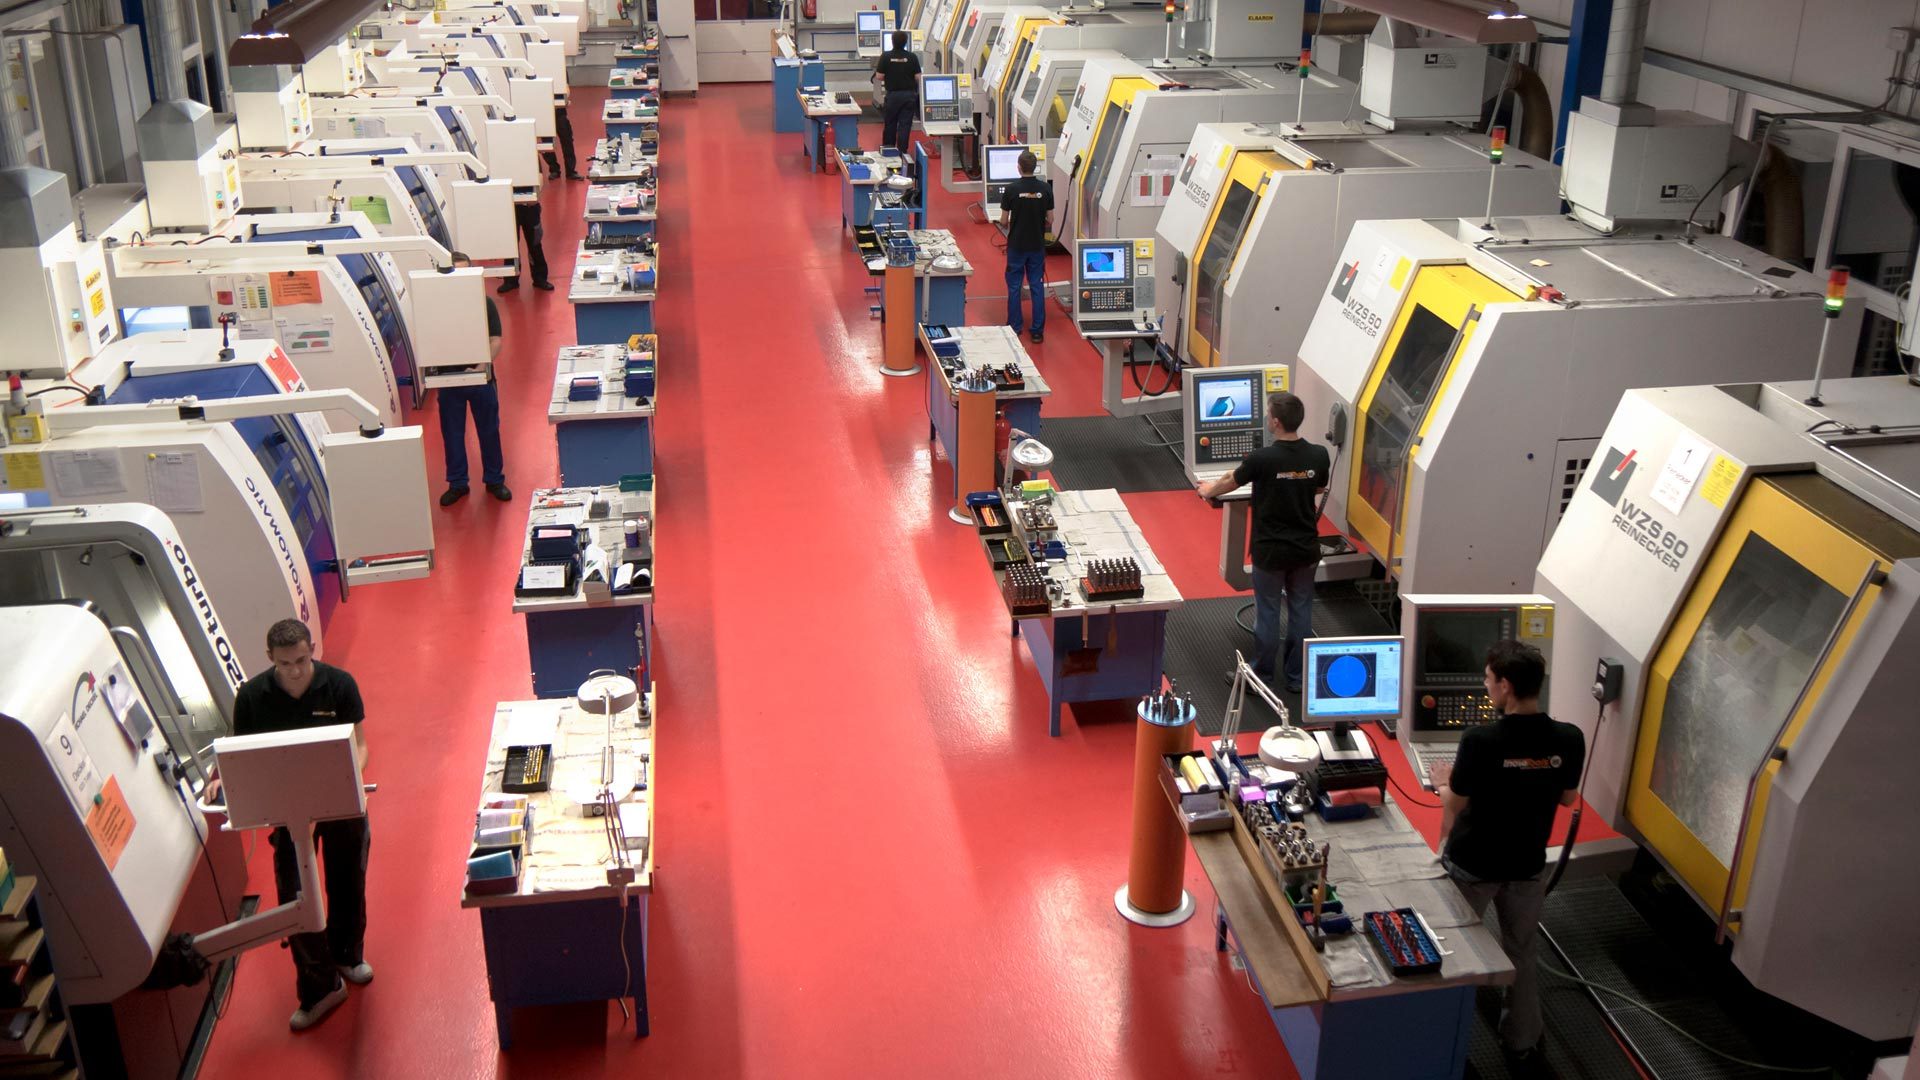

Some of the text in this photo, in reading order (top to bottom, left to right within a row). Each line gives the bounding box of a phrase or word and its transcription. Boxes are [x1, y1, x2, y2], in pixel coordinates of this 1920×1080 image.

[1342, 308, 1377, 338] REINECKER
[1347, 296, 1382, 330] WZS 60
[244, 476, 303, 597] ROLLOMATIC
[1612, 514, 1681, 573] REINECKER
[1620, 498, 1689, 559] WZS 60
[59, 734, 73, 756] 9
